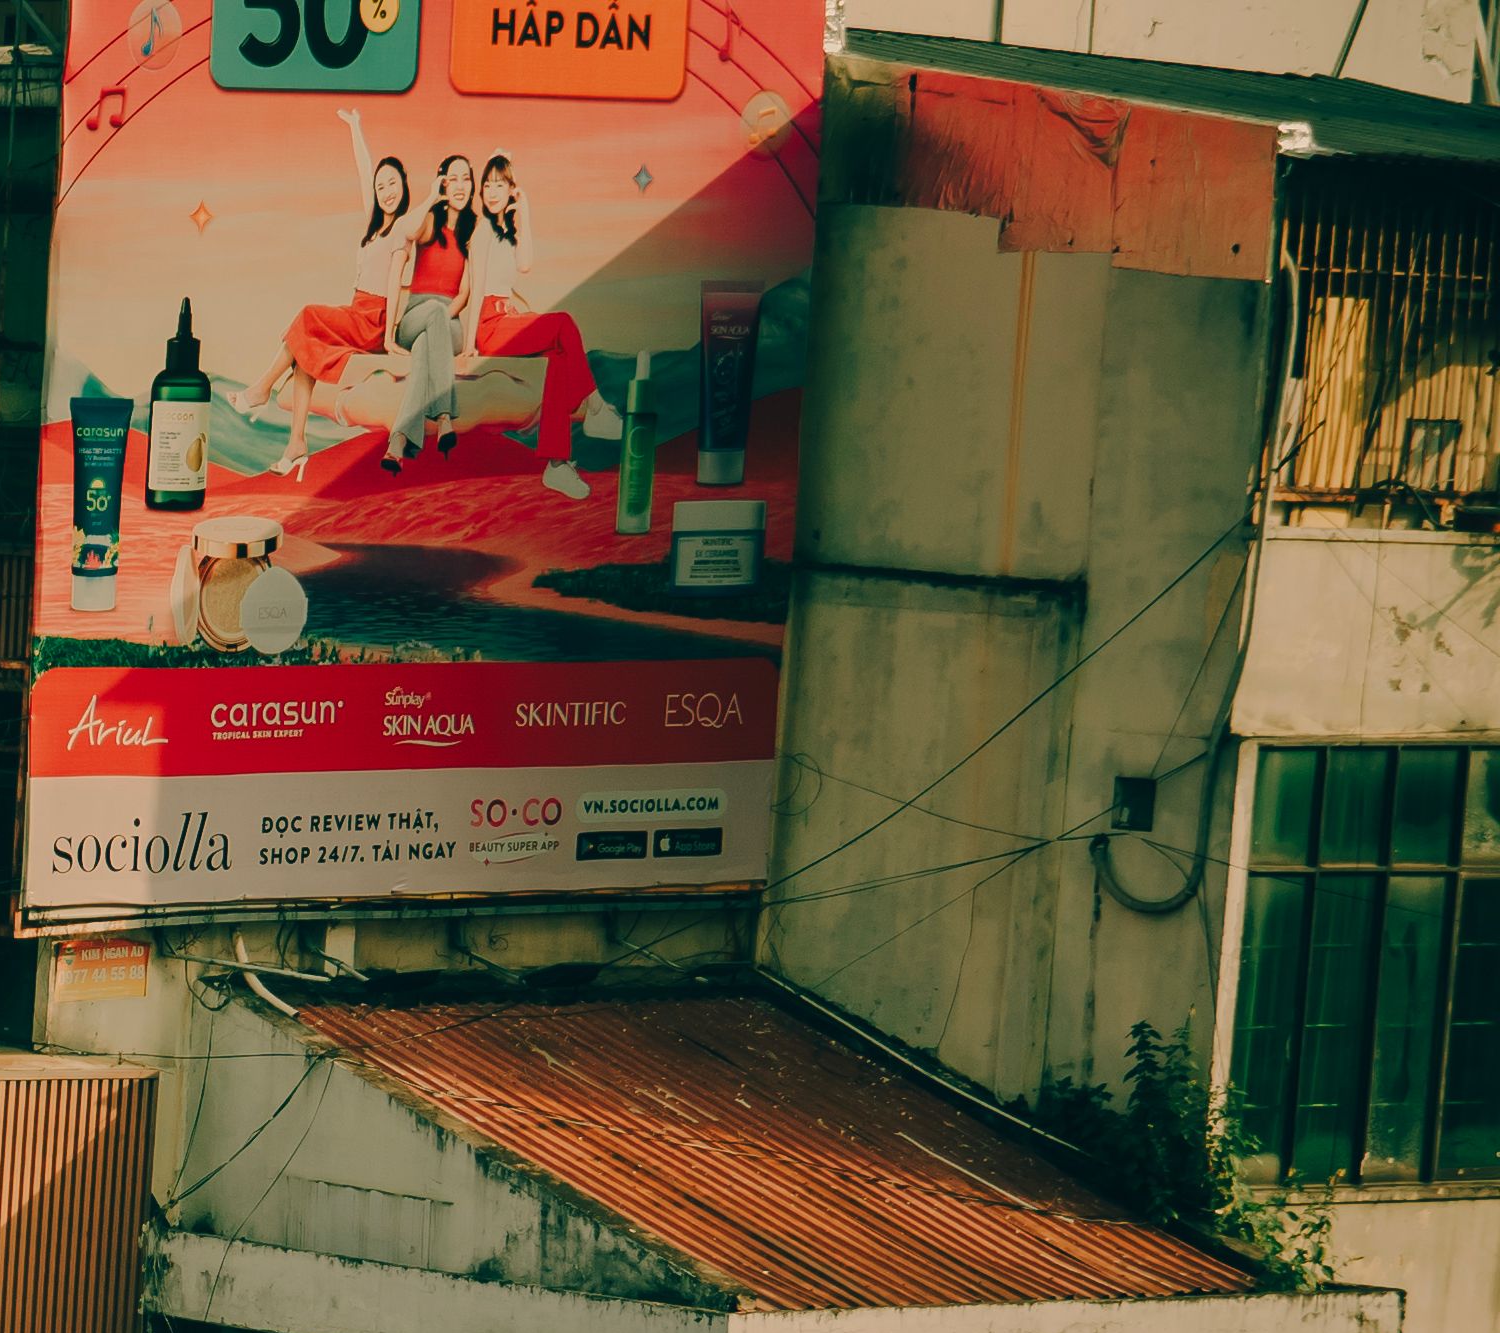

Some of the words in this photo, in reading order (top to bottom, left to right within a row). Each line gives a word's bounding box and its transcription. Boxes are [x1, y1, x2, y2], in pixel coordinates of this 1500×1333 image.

[211, 701, 344, 729] carasun
[515, 700, 627, 727] SKINTIFIC
[663, 692, 744, 729] ESQA
[382, 713, 423, 738] SKIN
[424, 712, 475, 737] AQUA
[583, 796, 719, 814] VN.SOCIOLLA.COM
[261, 813, 302, 838] ĐỌC
[310, 813, 381, 833] REVIEW
[388, 807, 439, 834] THẬT,
[52, 811, 232, 875] sociolla
[259, 846, 310, 866] SHOP
[318, 844, 365, 864] 24/7.
[373, 839, 401, 862] TẢI
[408, 841, 457, 860] NGAY
[469, 841, 505, 854] BEAUTY
[507, 840, 538, 852] SUPER
[540, 839, 560, 851] APP
[597, 842, 626, 855] Google
[627, 841, 643, 854] Play
